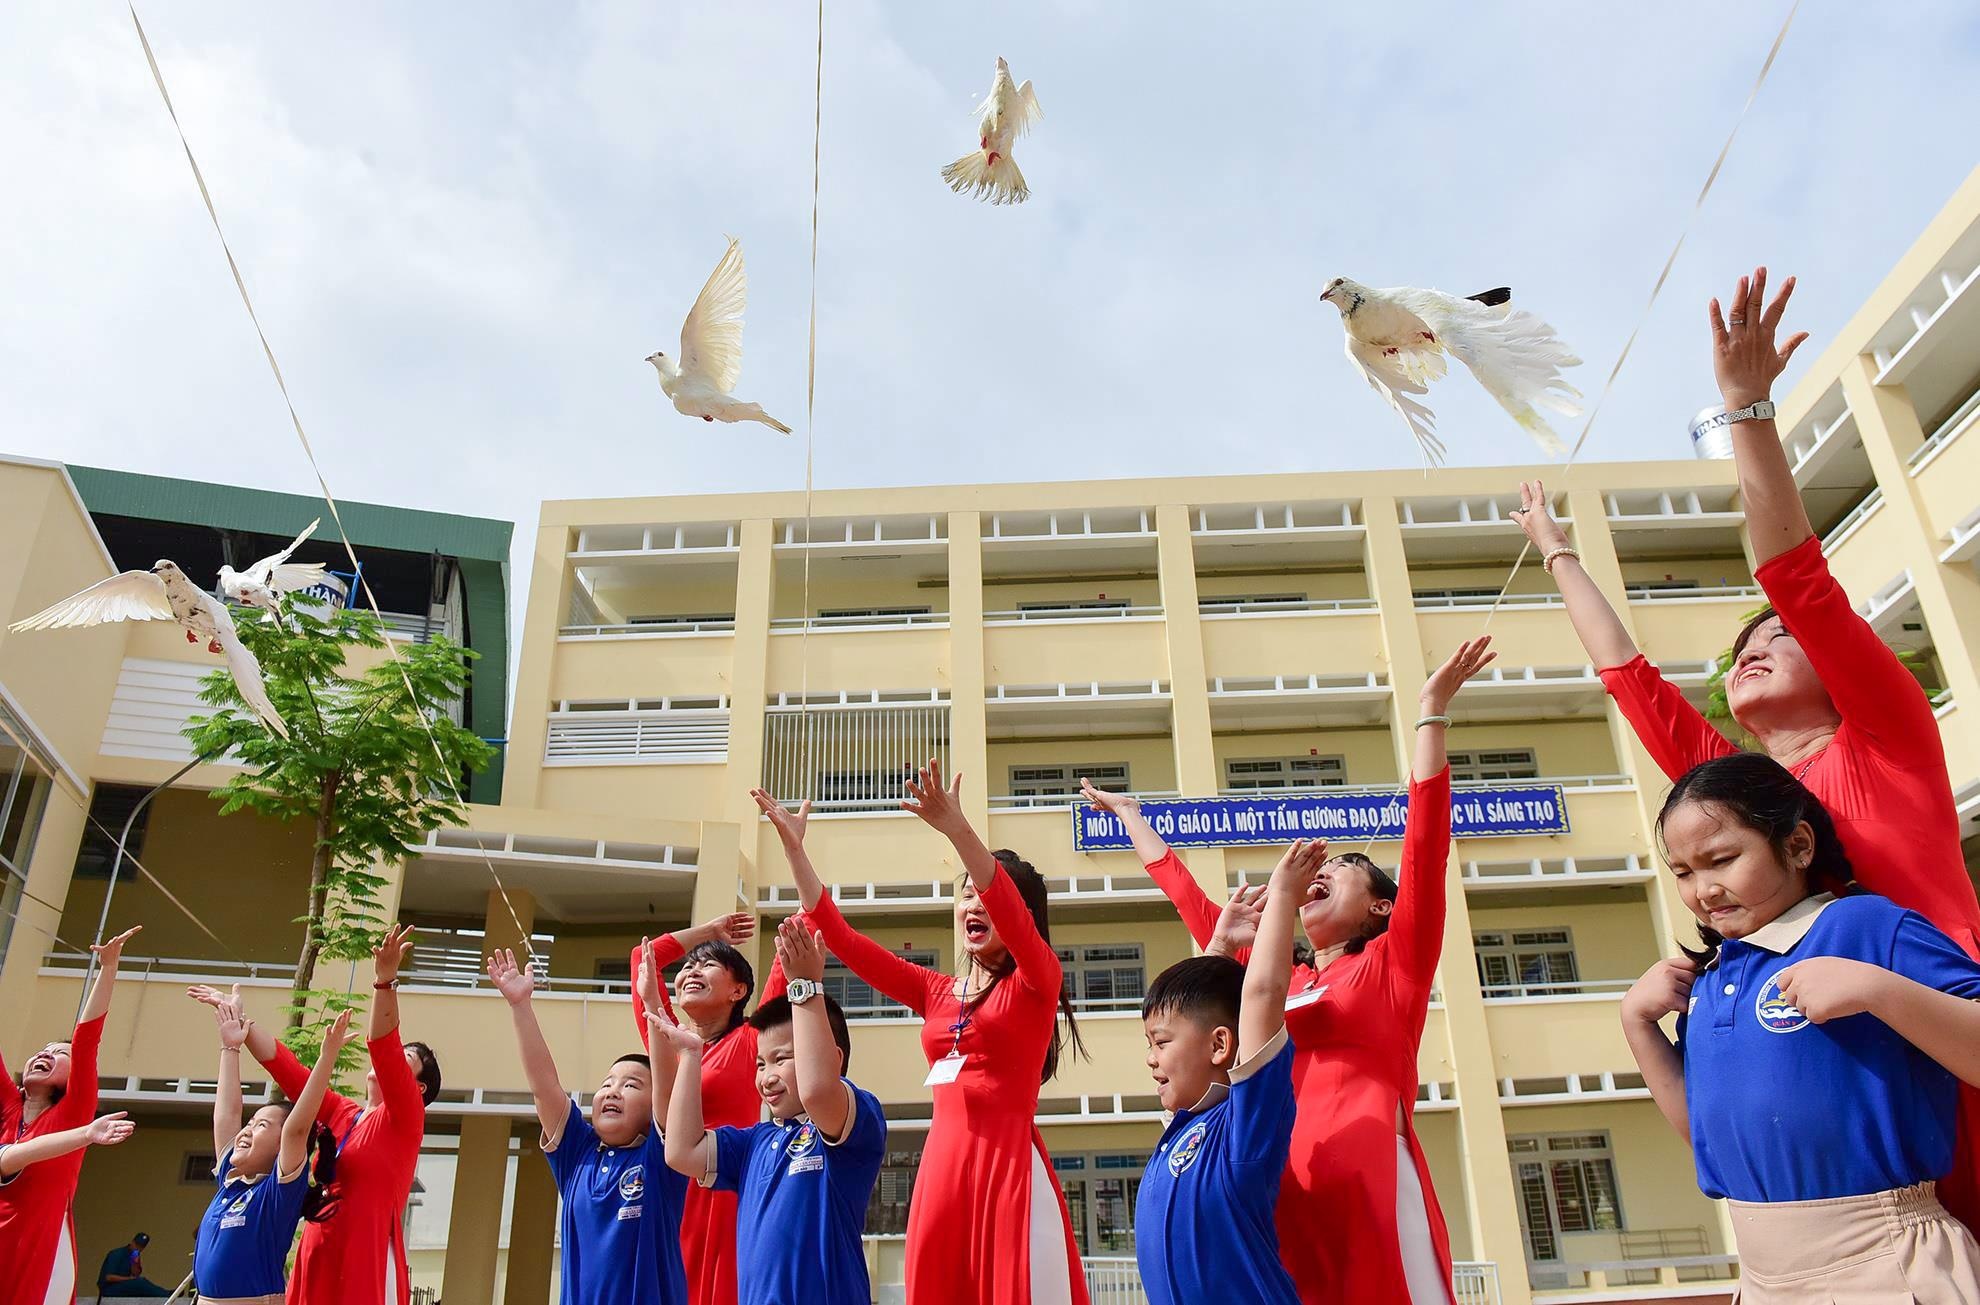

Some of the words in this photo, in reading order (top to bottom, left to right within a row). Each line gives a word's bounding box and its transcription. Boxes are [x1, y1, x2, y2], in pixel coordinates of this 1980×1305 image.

[1155, 809, 1175, 835] CÔ
[1178, 808, 1211, 834] GIÁO
[1213, 807, 1232, 833] LÀ
[1235, 806, 1265, 835] MỘT
[1267, 803, 1300, 831] TẤM
[1301, 806, 1347, 830] GƯƠNG
[1349, 807, 1379, 832] ĐẠO
[1464, 799, 1485, 824] VÀ
[1486, 797, 1525, 823] SÁNG
[1525, 800, 1555, 825] TẠO
